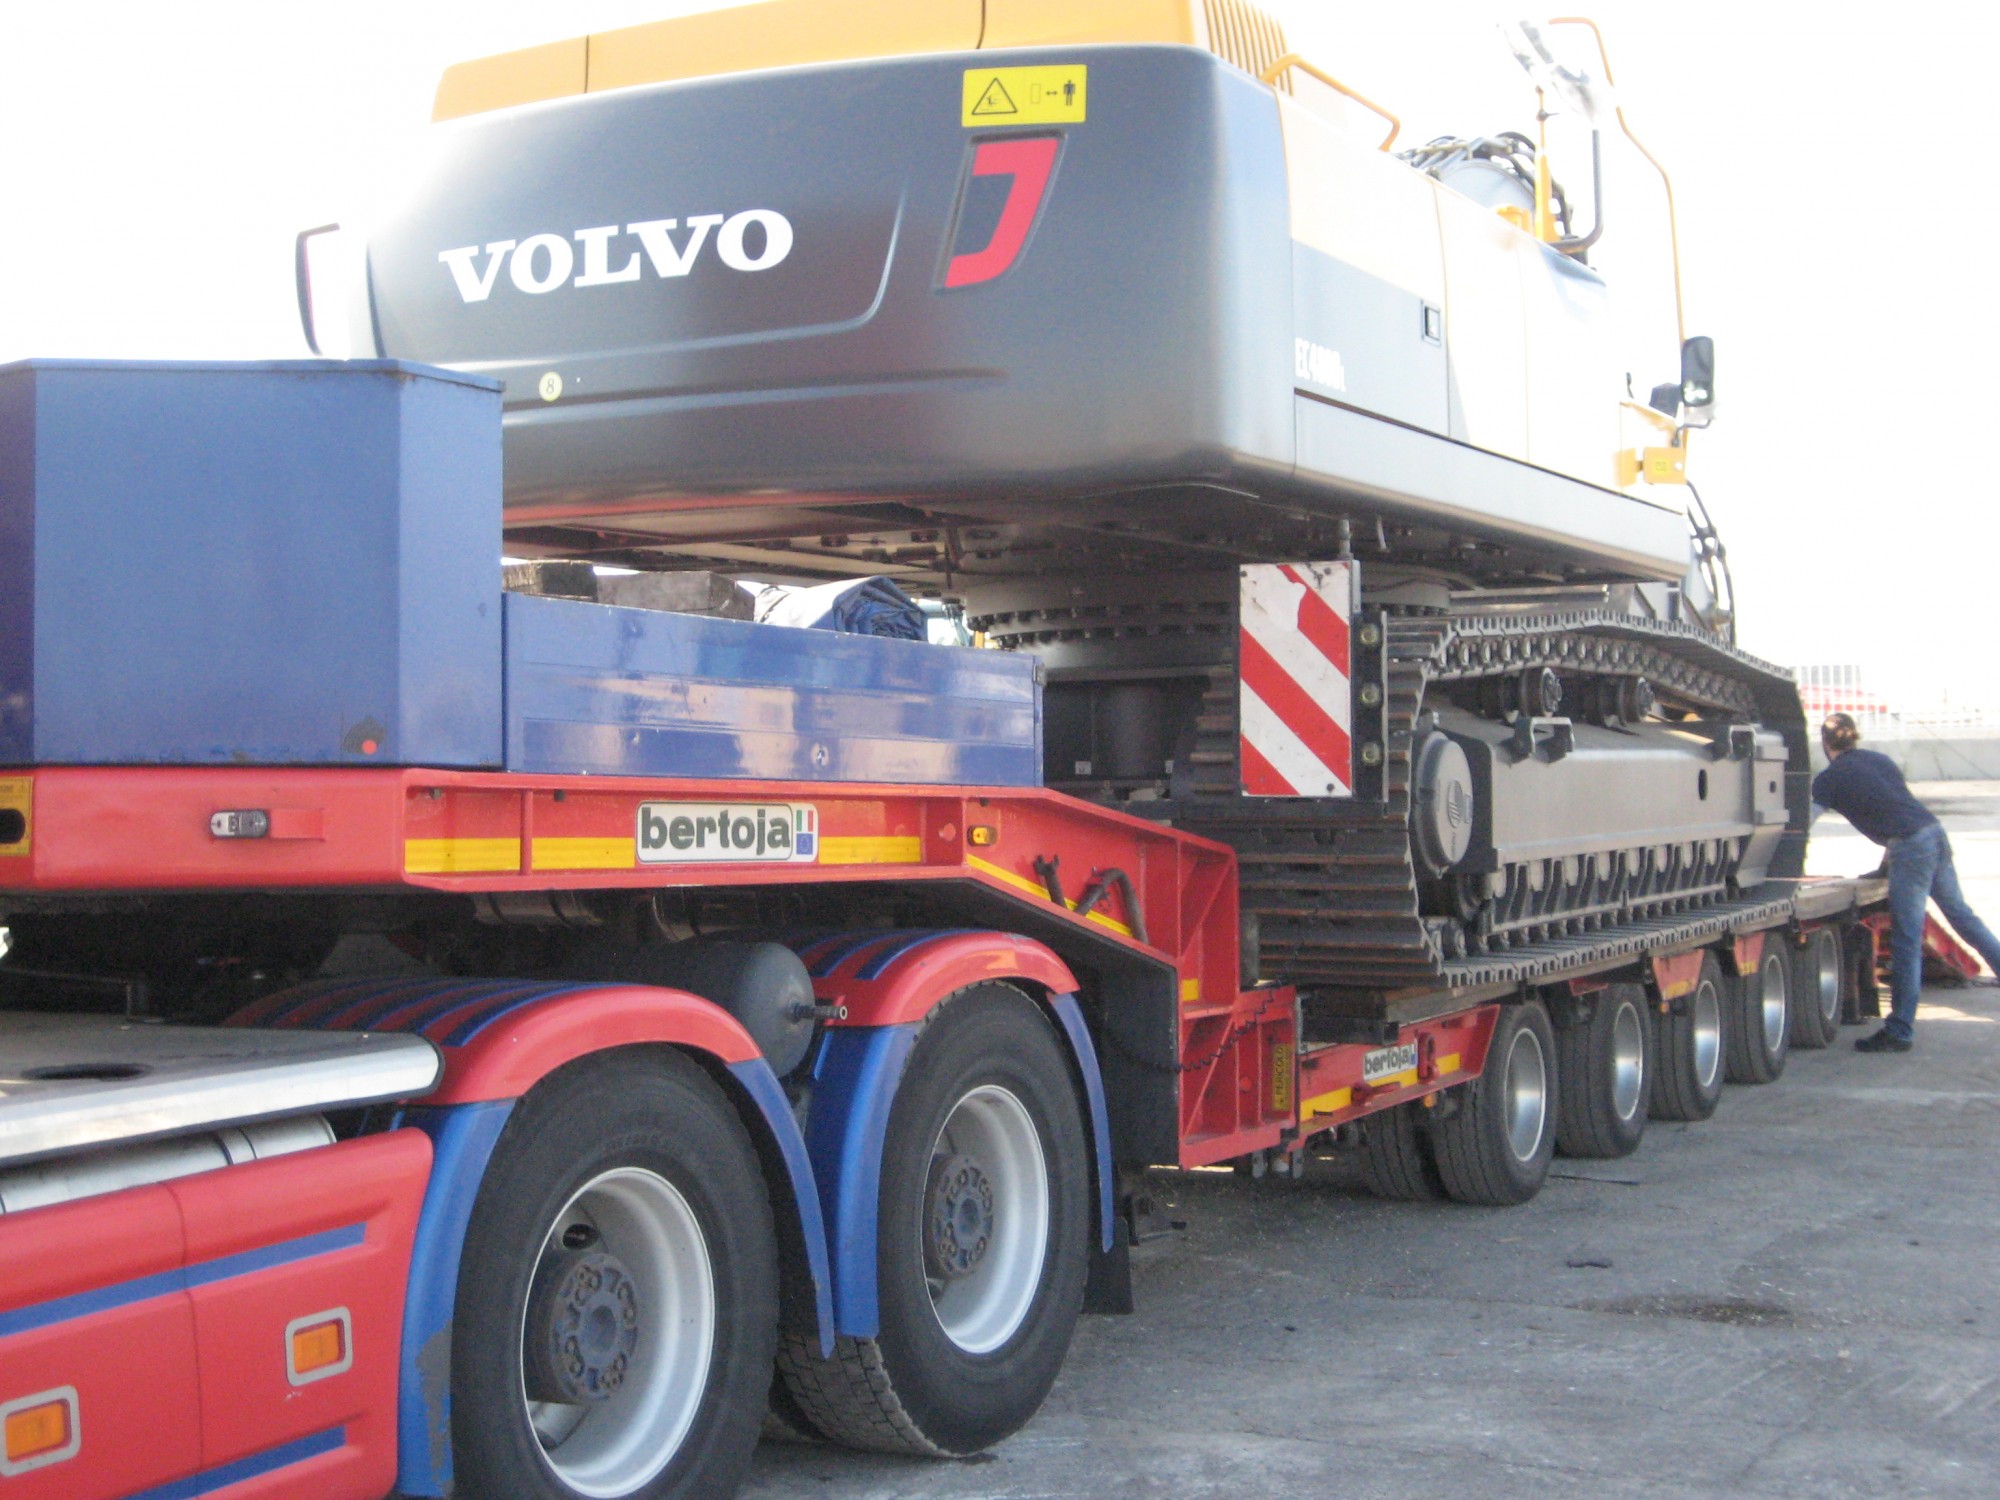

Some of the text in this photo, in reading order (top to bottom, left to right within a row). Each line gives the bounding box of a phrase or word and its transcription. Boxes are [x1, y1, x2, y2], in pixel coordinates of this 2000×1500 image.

[438, 208, 793, 303] VOLVO
[641, 807, 790, 855] bertoja
[1365, 1046, 1409, 1075] bertoja
